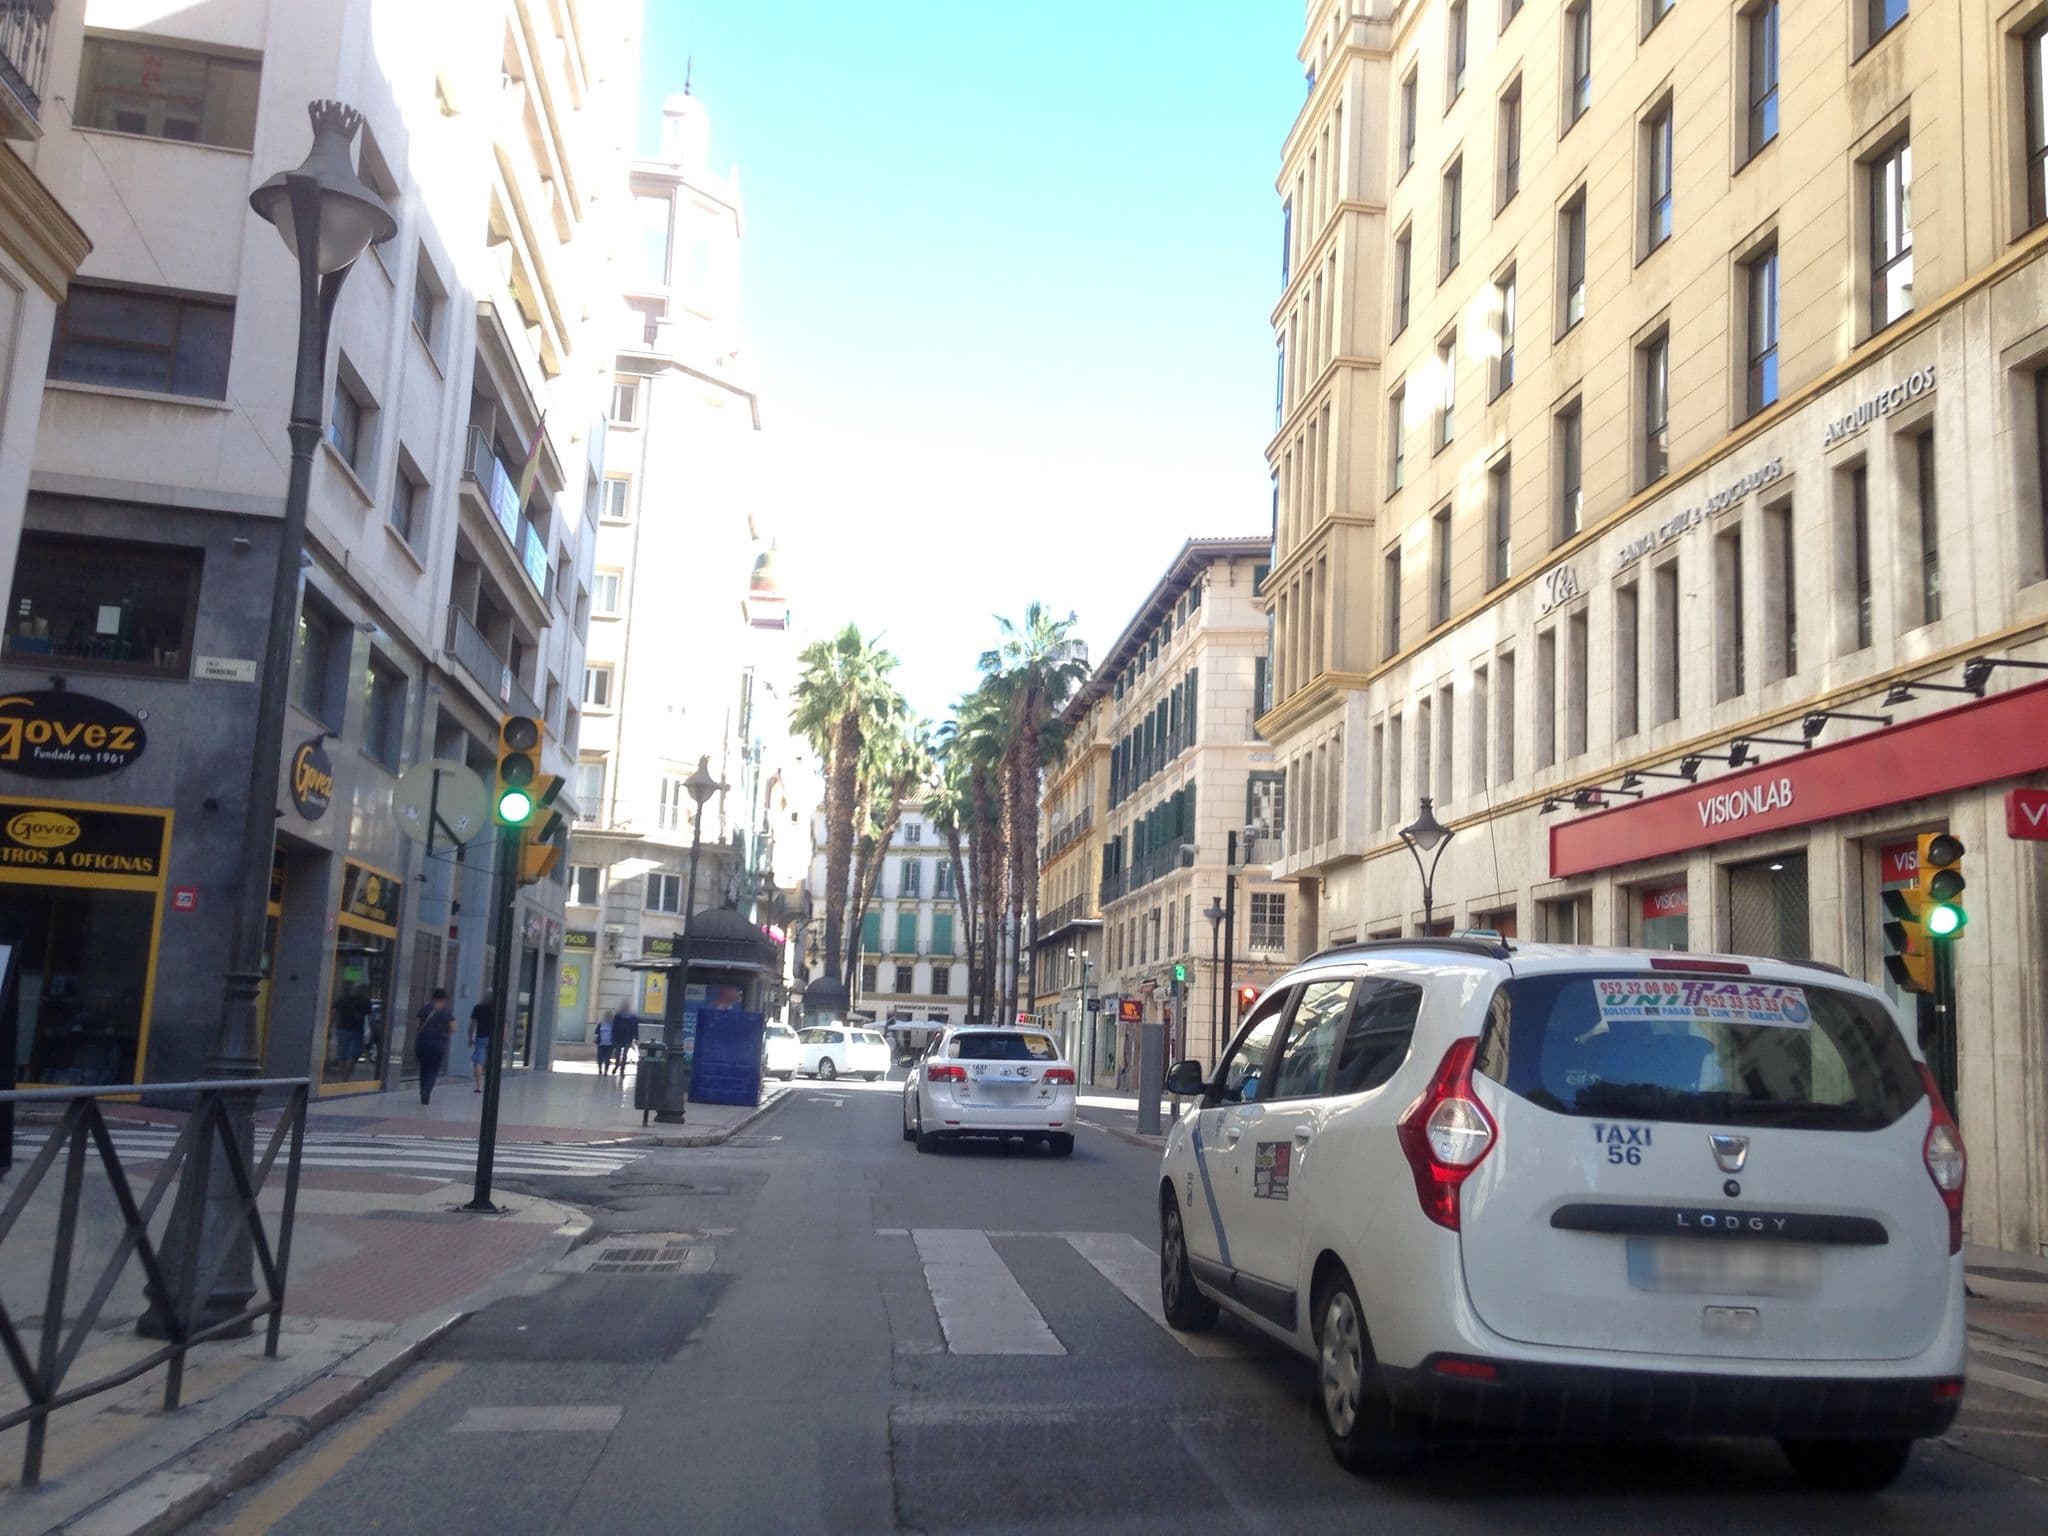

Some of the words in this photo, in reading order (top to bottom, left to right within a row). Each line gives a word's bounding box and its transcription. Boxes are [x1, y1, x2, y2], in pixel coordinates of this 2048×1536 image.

[1824, 365, 1936, 447] ARQUITECTOS
[96, 753, 124, 764] 1961
[1697, 778, 1793, 828] VISIONLAB
[12, 815, 77, 840] Govez
[53, 851, 67, 866] A
[71, 852, 154, 872] OFICINAS
[1600, 982, 1622, 995] 952
[1626, 982, 1641, 995] 32
[1645, 982, 1660, 995] 00
[1663, 982, 1678, 995] 00
[1703, 994, 1725, 1008] 952
[1729, 995, 1744, 1009] 33
[1747, 997, 1761, 1010] 33
[1764, 998, 1779, 1012] 33
[1592, 1123, 1652, 1147] TAXI
[1607, 1145, 1642, 1166] 56
[1677, 1213, 1785, 1231] LODGY
